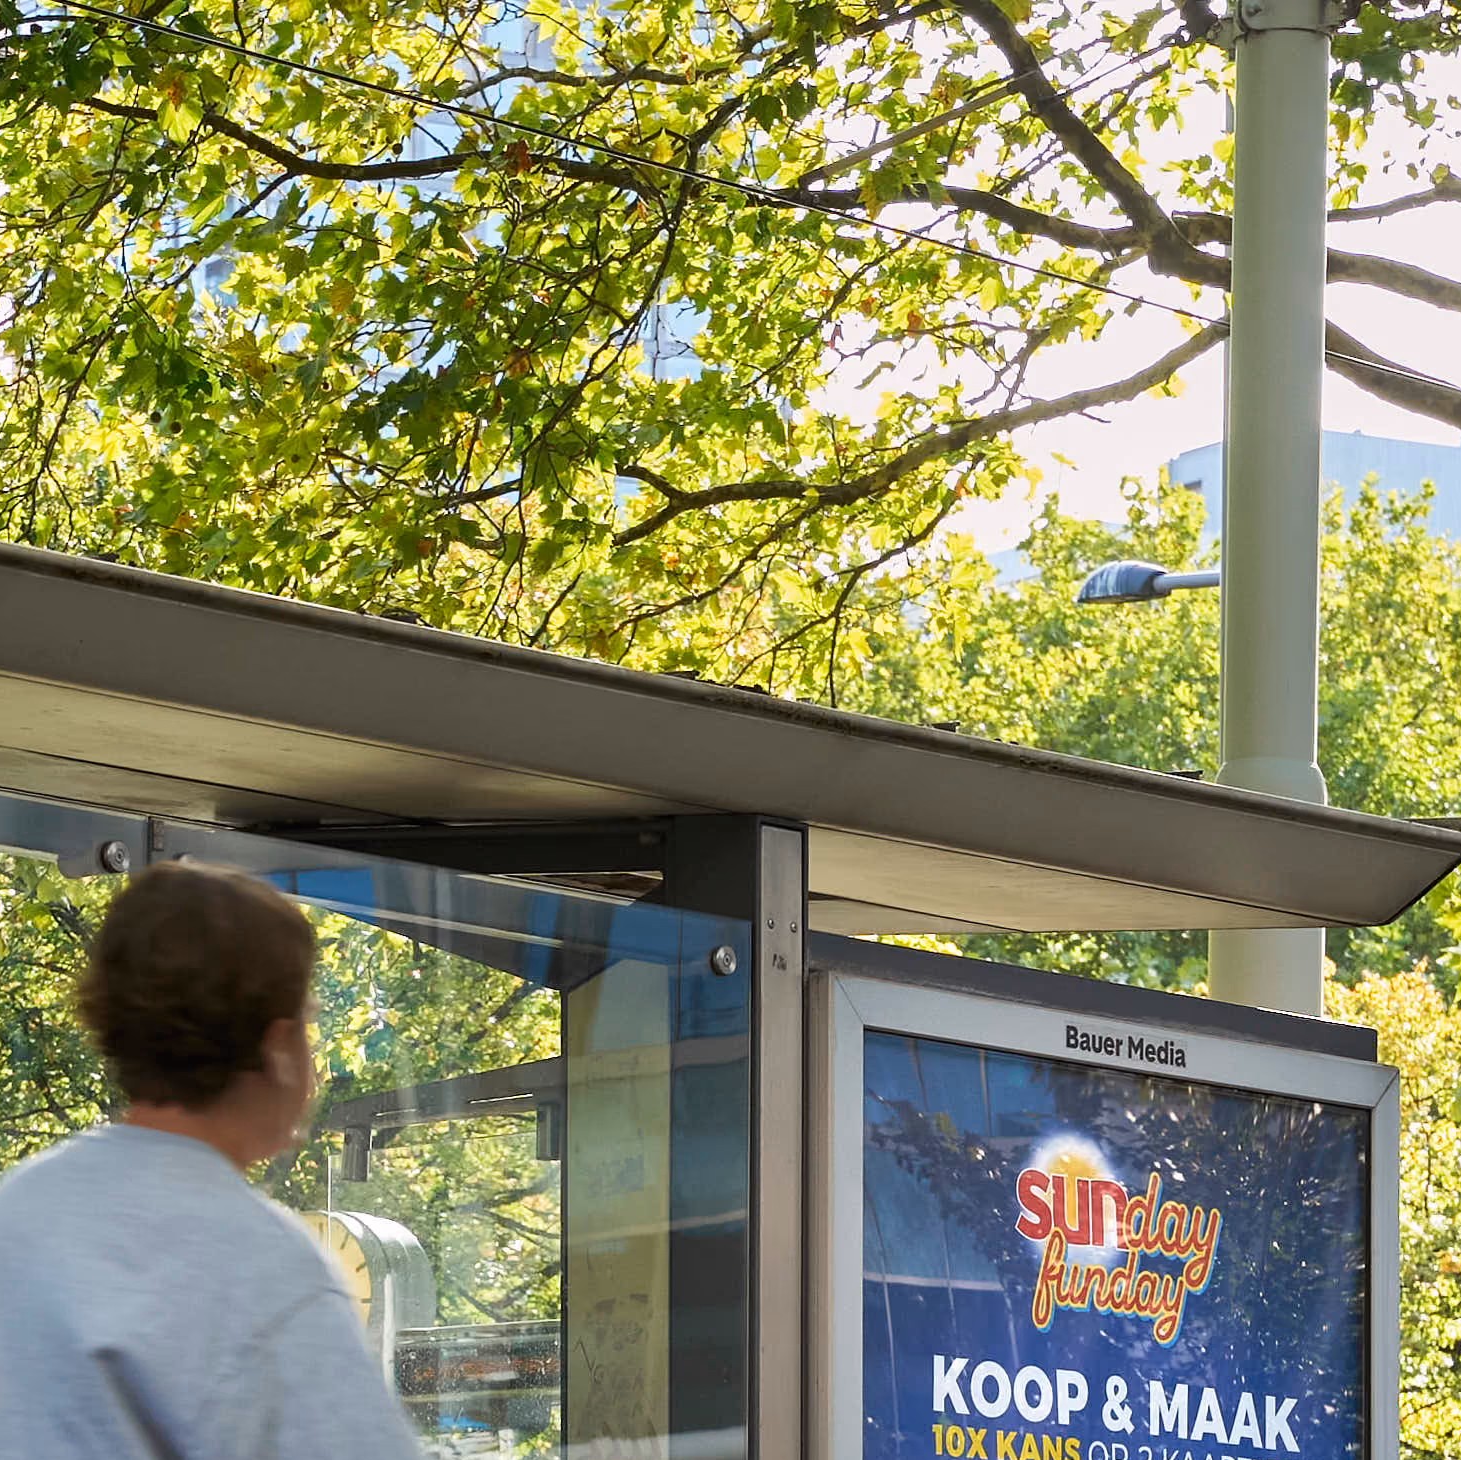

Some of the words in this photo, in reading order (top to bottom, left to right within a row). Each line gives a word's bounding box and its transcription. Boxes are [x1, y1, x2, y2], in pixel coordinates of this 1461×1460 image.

[1066, 1025, 1123, 1057] Bauer
[1128, 1035, 1186, 1068] Media
[1032, 1228, 1188, 1348] funday
[932, 1354, 1089, 1425] KOOP
[1102, 1375, 1135, 1435] &
[1149, 1380, 1301, 1453] MAAK
[932, 1424, 988, 1460] 10X
